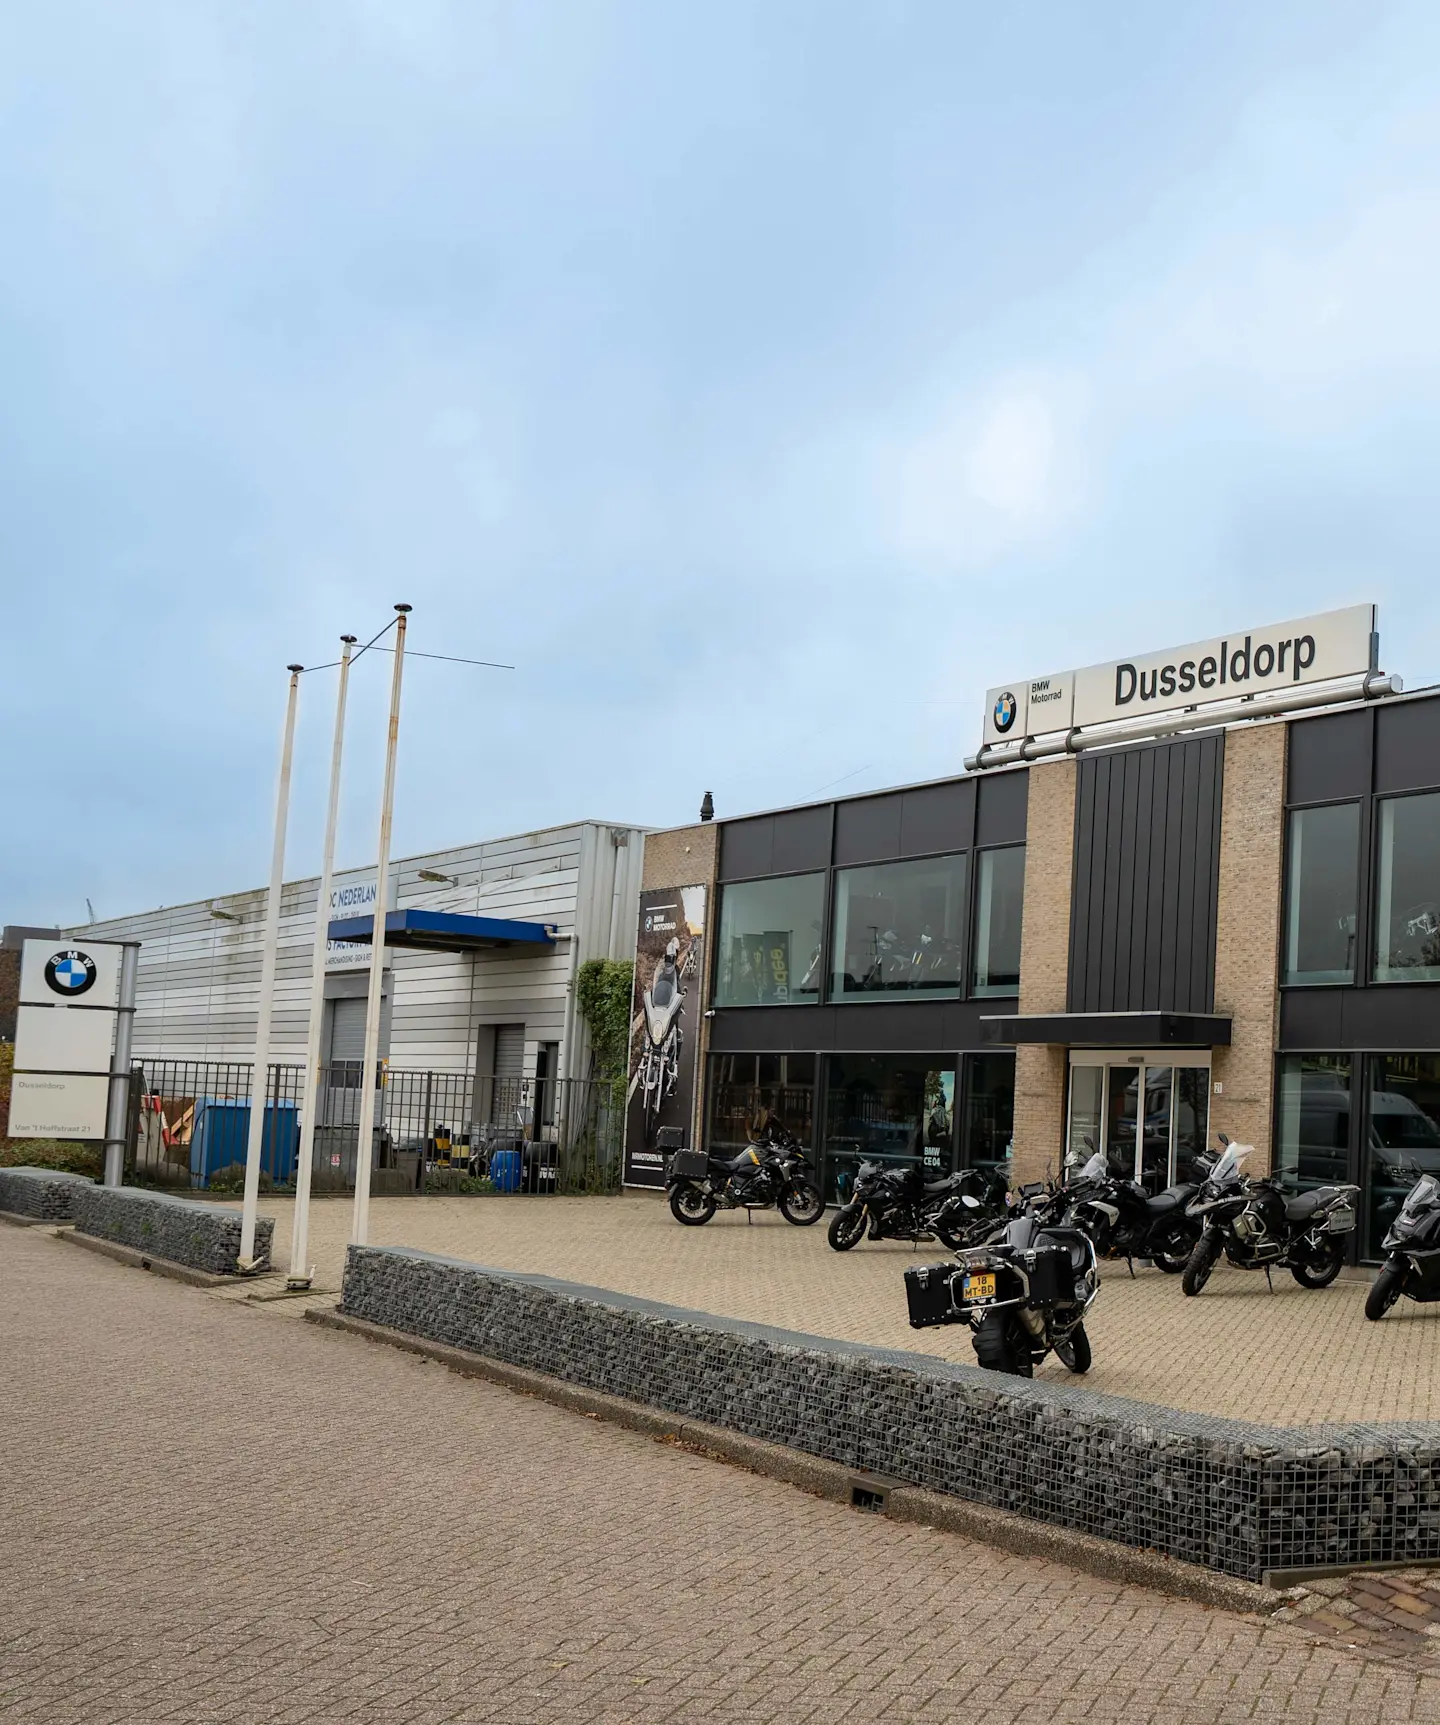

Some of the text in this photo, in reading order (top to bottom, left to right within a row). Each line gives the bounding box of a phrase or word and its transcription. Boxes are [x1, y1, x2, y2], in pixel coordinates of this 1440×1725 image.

[1115, 635, 1316, 706] Dusseldorp
[1031, 680, 1050, 693] BMW
[1031, 688, 1062, 704] Motorrad
[338, 884, 377, 907] NEDERLAN
[653, 914, 665, 923] BMW
[653, 921, 677, 931] MOTORRAD
[50, 951, 94, 968] BMW
[18, 1081, 66, 1090] Dusseldorp
[924, 1146, 941, 1157] BMW
[923, 1156, 932, 1166] CE
[977, 1276, 987, 1286] 18
[964, 1285, 994, 1297] MT-BD
